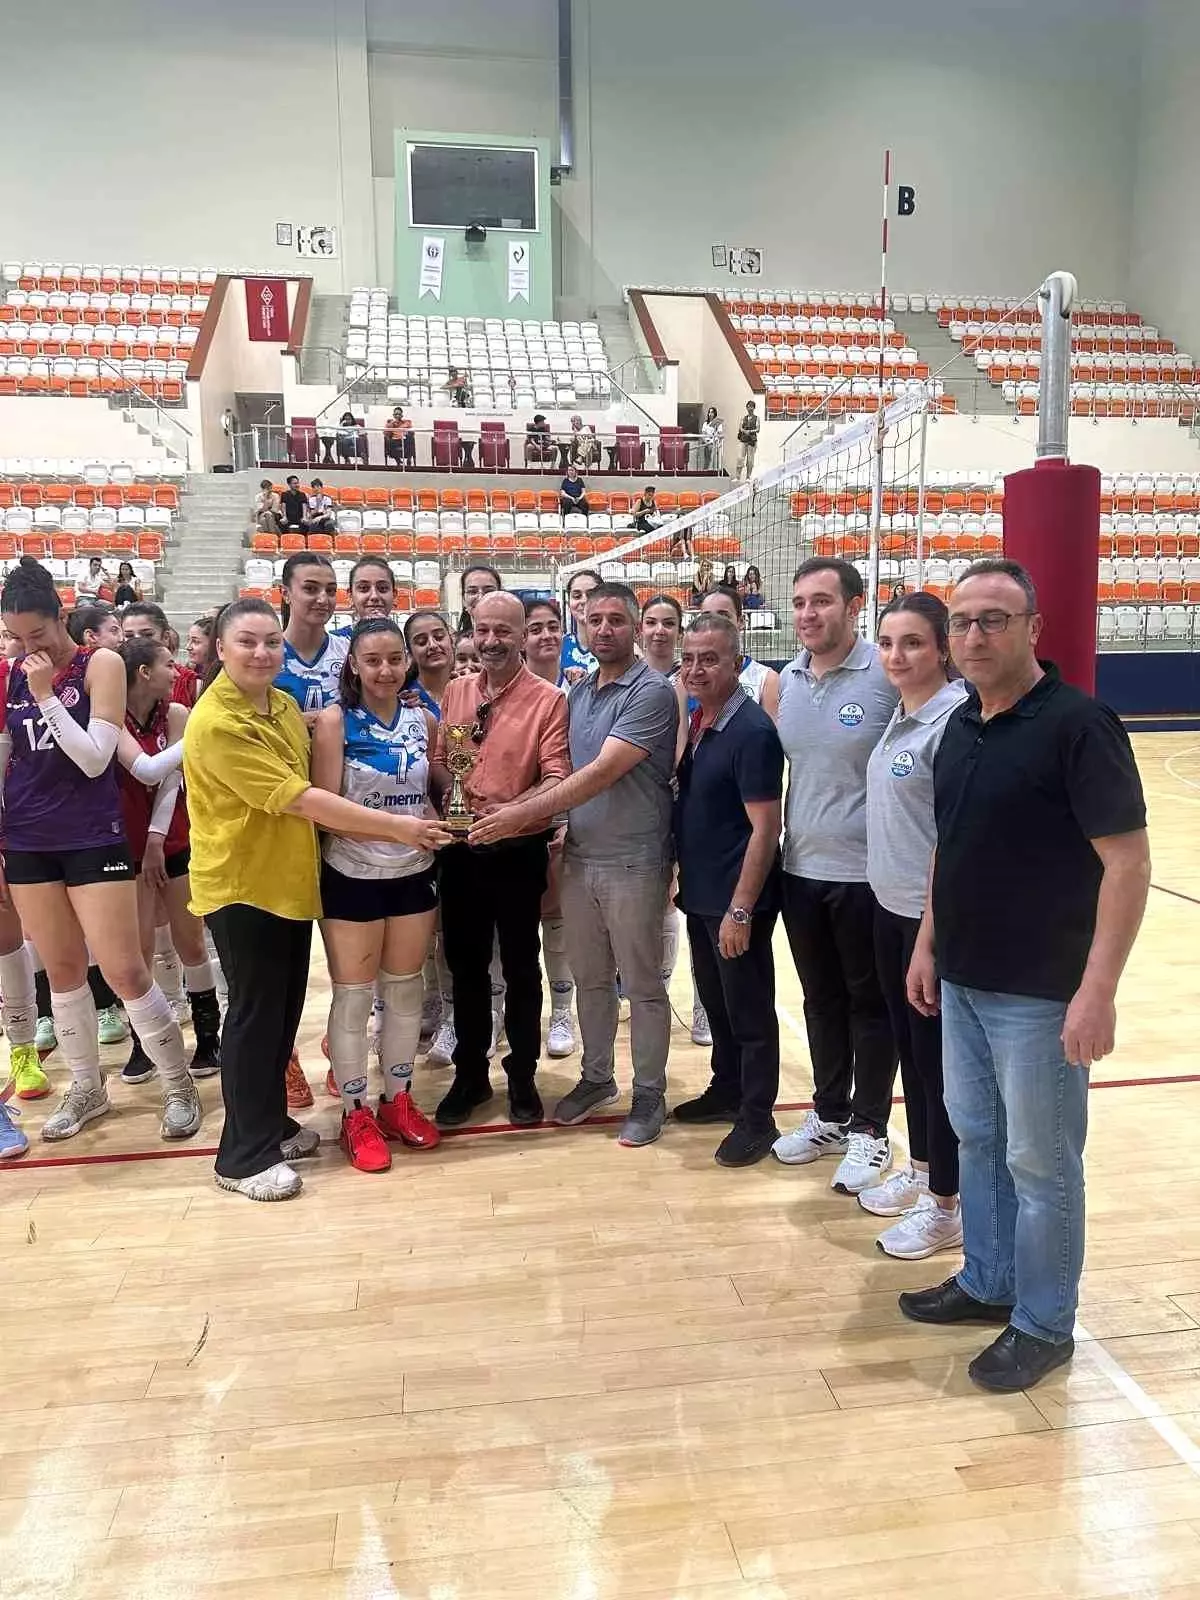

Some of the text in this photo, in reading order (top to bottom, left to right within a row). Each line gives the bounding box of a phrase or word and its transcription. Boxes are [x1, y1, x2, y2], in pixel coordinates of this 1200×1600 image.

[898, 185, 915, 215] B
[304, 685, 323, 712] 4
[22, 718, 54, 751] 12
[388, 744, 408, 784] 7
